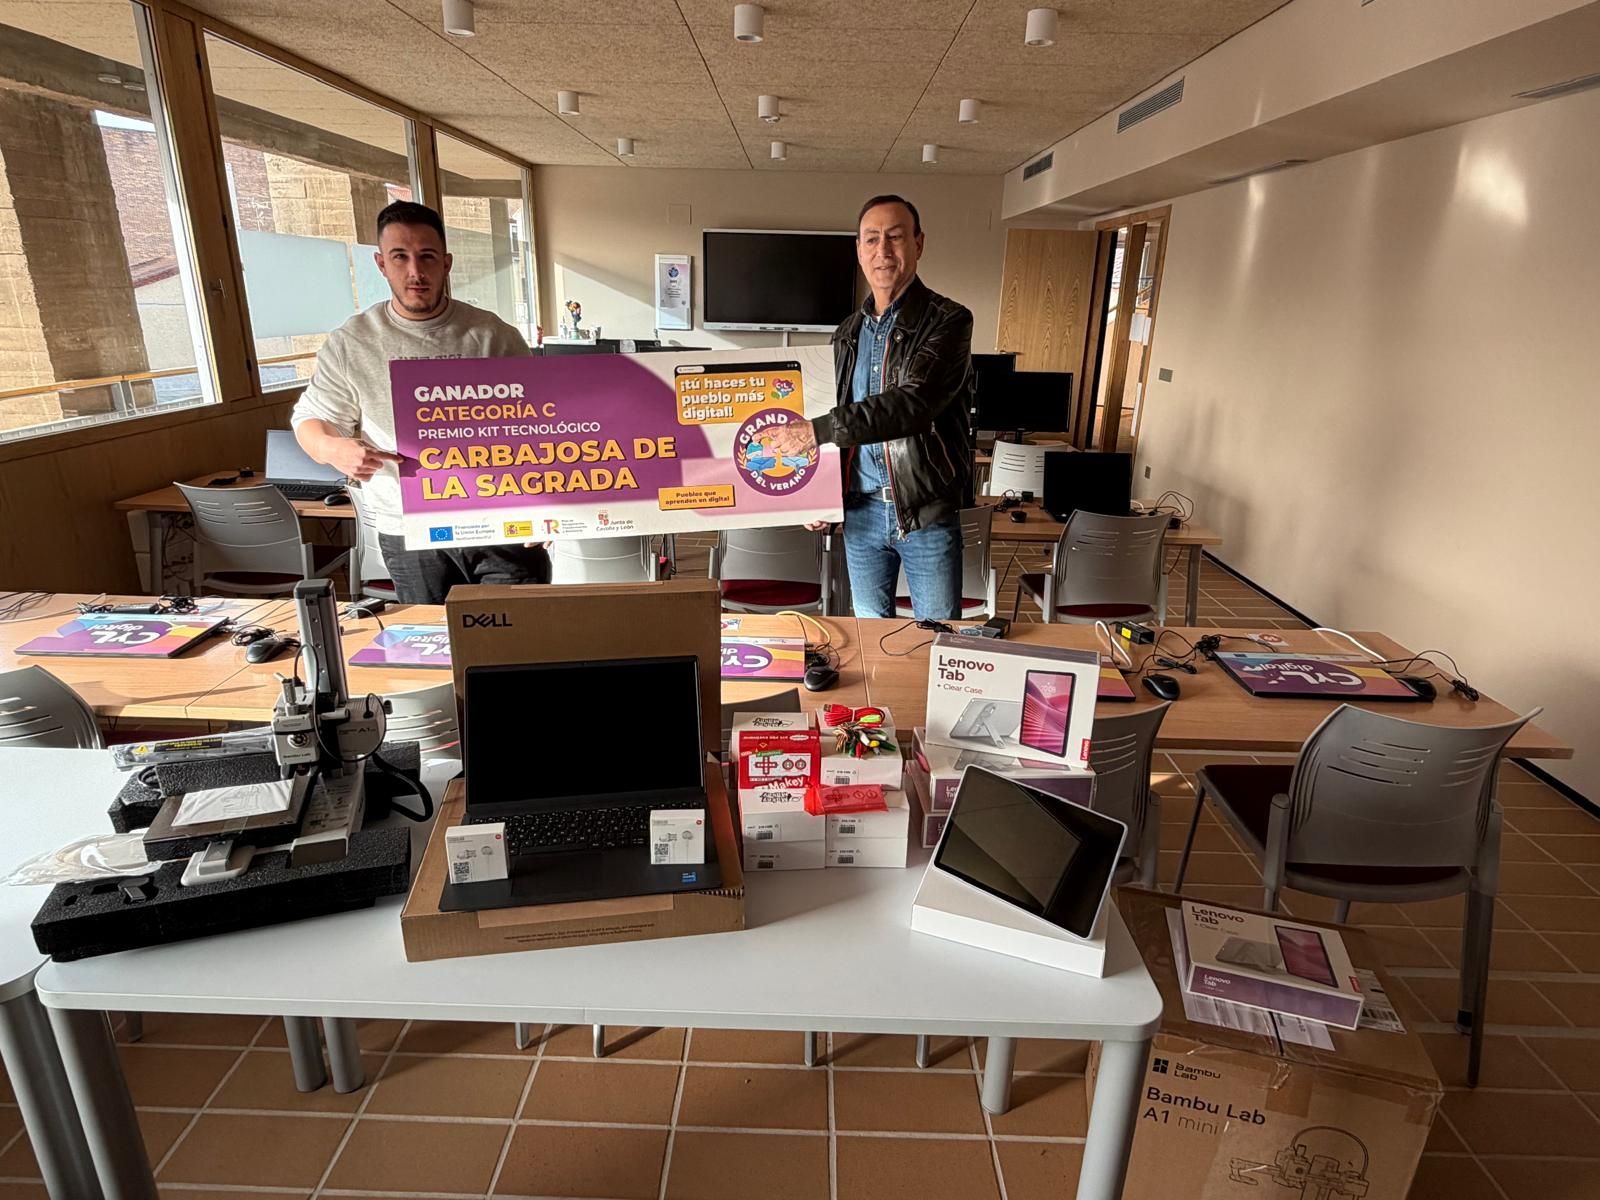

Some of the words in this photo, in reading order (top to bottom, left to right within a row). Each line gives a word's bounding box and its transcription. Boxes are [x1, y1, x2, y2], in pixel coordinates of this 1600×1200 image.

[414, 383, 525, 402] GANADOR
[680, 377, 700, 392] ¡tú
[704, 376, 746, 389] haces
[749, 376, 765, 388] tu
[681, 392, 731, 407] pueblo
[735, 390, 765, 402] más
[416, 400, 538, 422] CATEGORÍA
[542, 402, 556, 417] C
[682, 406, 733, 421] digital!
[418, 427, 475, 440] PREMIO
[478, 426, 500, 437] KIT
[502, 421, 601, 436] TECNOLÓGICO
[739, 413, 788, 445] GRAND
[419, 439, 627, 470] CARBAJOSA
[633, 436, 677, 460] DE
[422, 475, 469, 500] LA
[475, 466, 640, 498] SAGRADA
[750, 470, 767, 488] DEL
[770, 468, 806, 491] VERANO
[665, 497, 697, 506] aprenden
[708, 496, 729, 504] digital
[462, 612, 513, 628] DELL
[938, 654, 995, 672] Lenovo
[938, 667, 965, 681] Tab
[943, 683, 962, 692] Clear
[964, 686, 983, 694] Case
[1081, 740, 1090, 760] Lenovo
[1192, 905, 1245, 923] Lenovo
[1192, 912, 1219, 925] Tab
[1203, 979, 1217, 987] Tab
[1204, 973, 1231, 985] Lenovo
[1174, 1070, 1198, 1081] Lab
[1175, 1062, 1221, 1079] Bambu
[1146, 1086, 1220, 1115] Bambu
[1226, 1103, 1266, 1125] Lab
[1143, 1106, 1170, 1124] A1
[1178, 1115, 1220, 1135] mini
